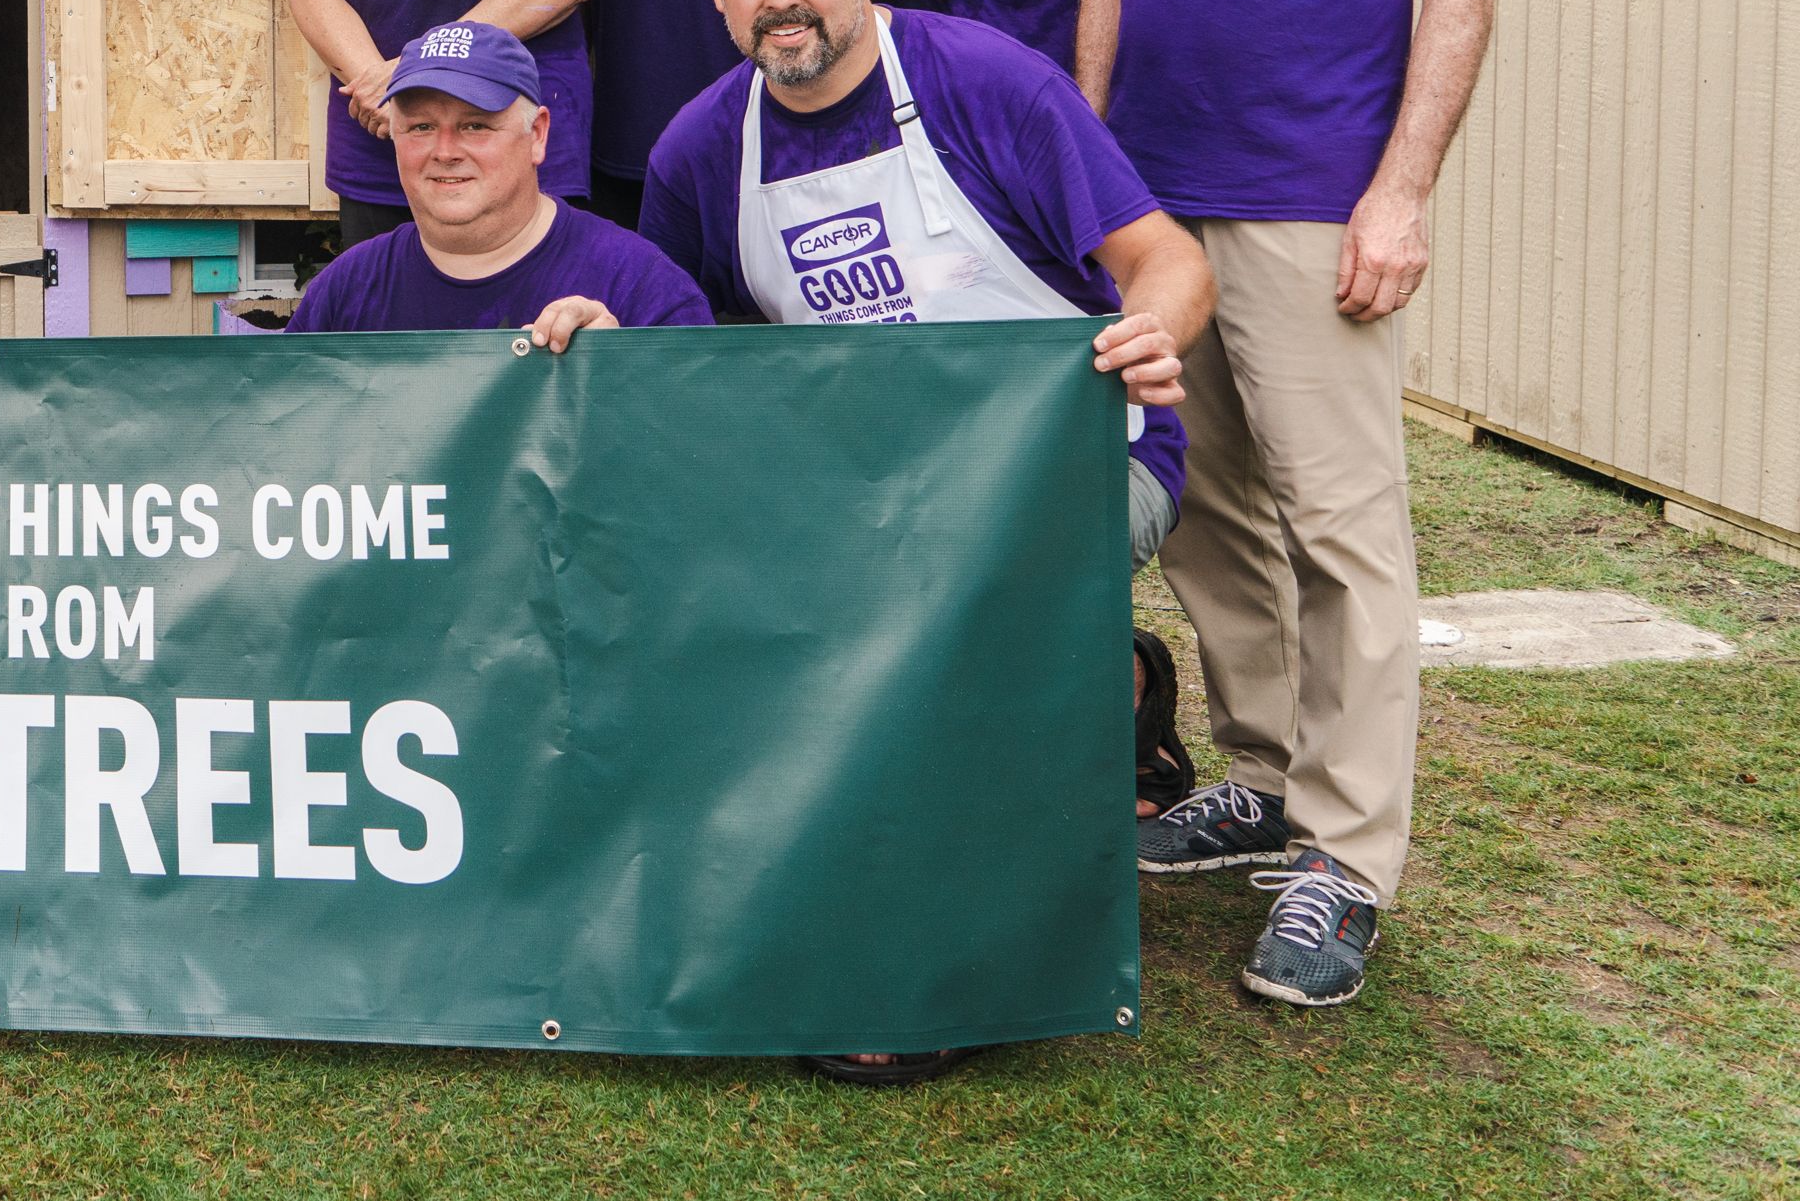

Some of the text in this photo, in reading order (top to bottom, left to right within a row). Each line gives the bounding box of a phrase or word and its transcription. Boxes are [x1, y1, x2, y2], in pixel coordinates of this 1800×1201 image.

[428, 27, 474, 41] GOOD
[420, 43, 470, 58] TREES
[800, 222, 872, 254] CANFOR
[800, 254, 904, 311] GOOD
[819, 309, 856, 323] THINGS
[856, 302, 884, 319] COME
[885, 296, 913, 314] FROM
[252, 484, 450, 560] COME
